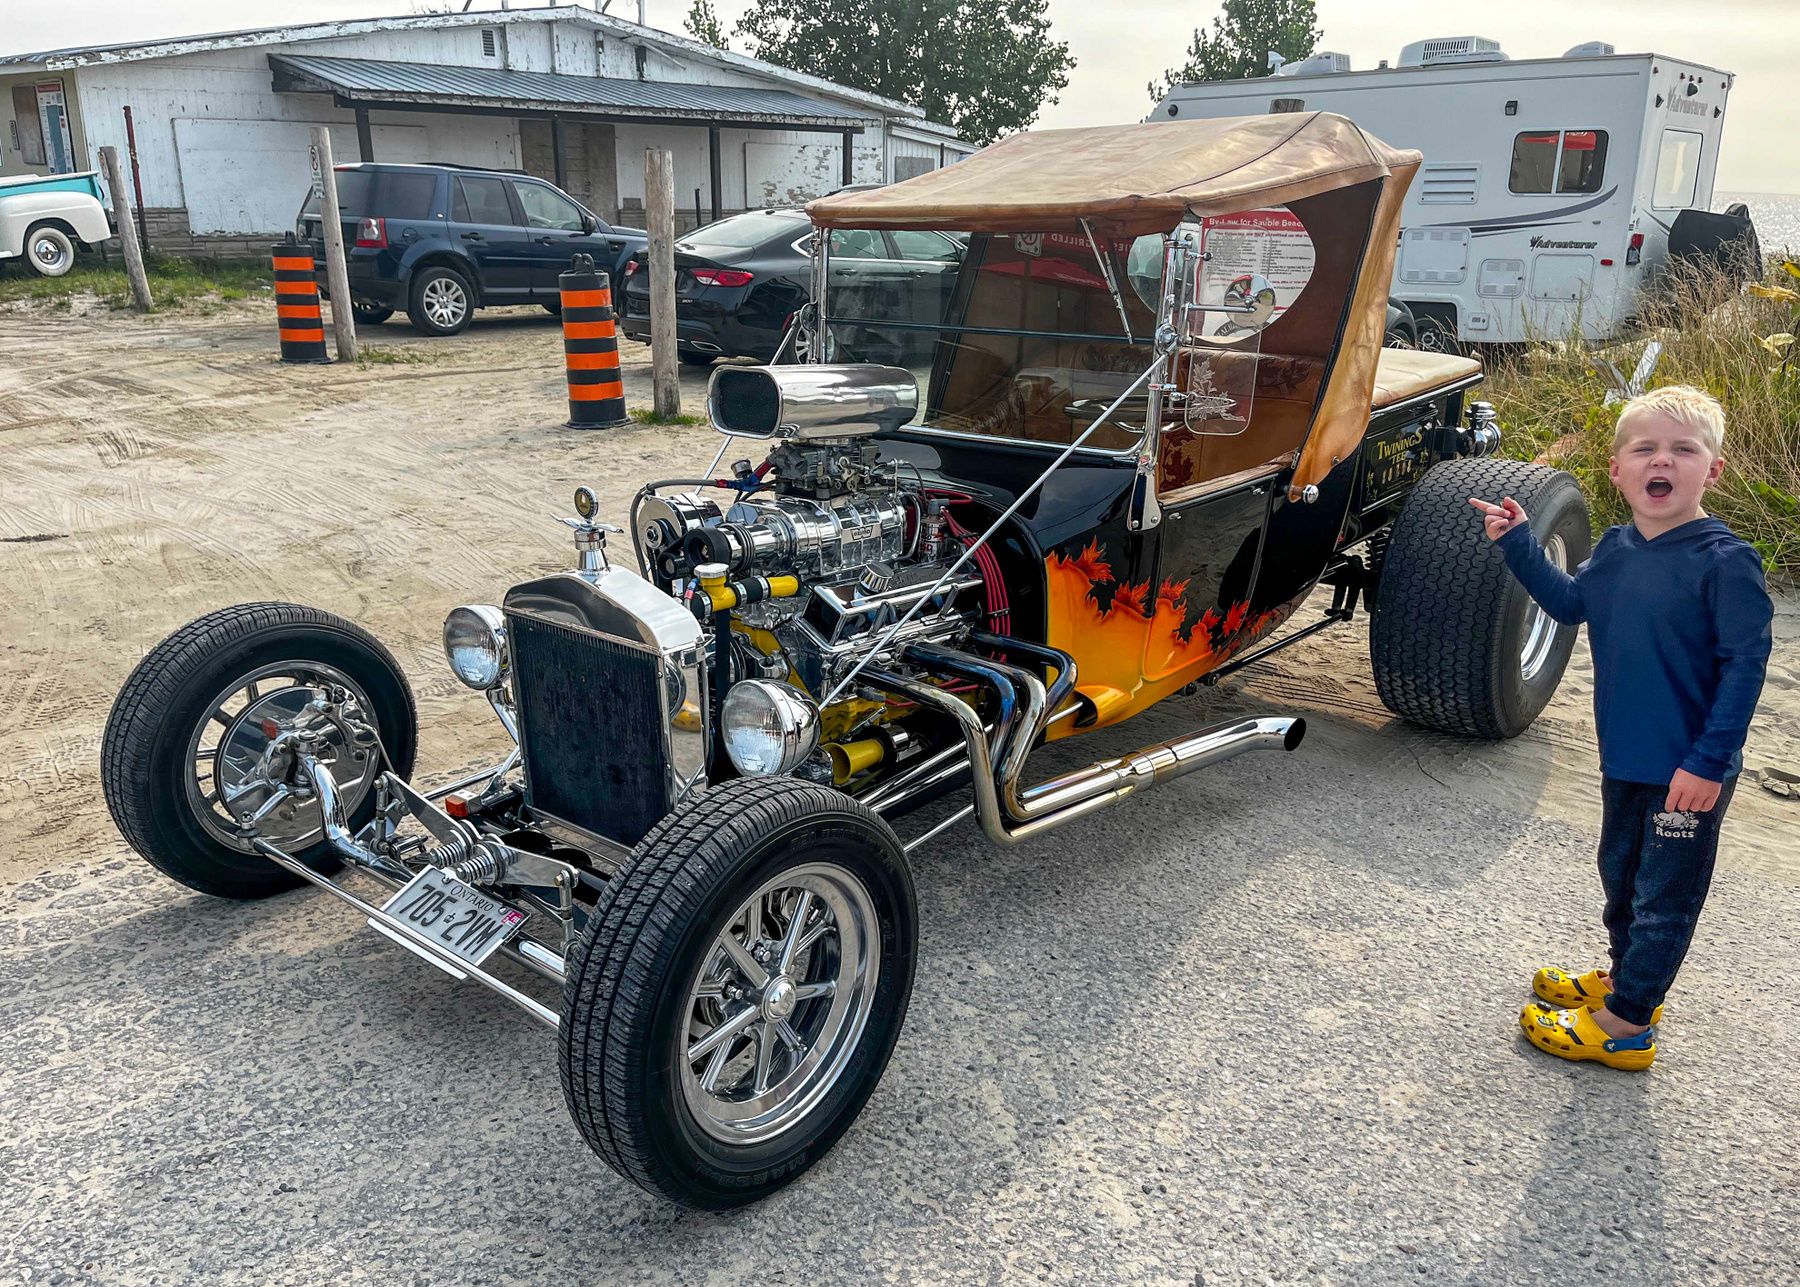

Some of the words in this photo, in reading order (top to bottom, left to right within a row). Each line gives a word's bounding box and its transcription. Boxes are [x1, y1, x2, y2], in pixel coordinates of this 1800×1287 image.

[1240, 218, 1251, 226] for
[1252, 219, 1280, 227] Sauble
[1281, 220, 1304, 228] Beac
[1535, 239, 1598, 249] Adventurer
[1655, 827, 1695, 838] Roots
[450, 884, 495, 912] ONTARIO
[398, 883, 457, 927] 705
[440, 909, 504, 956] 2VM
